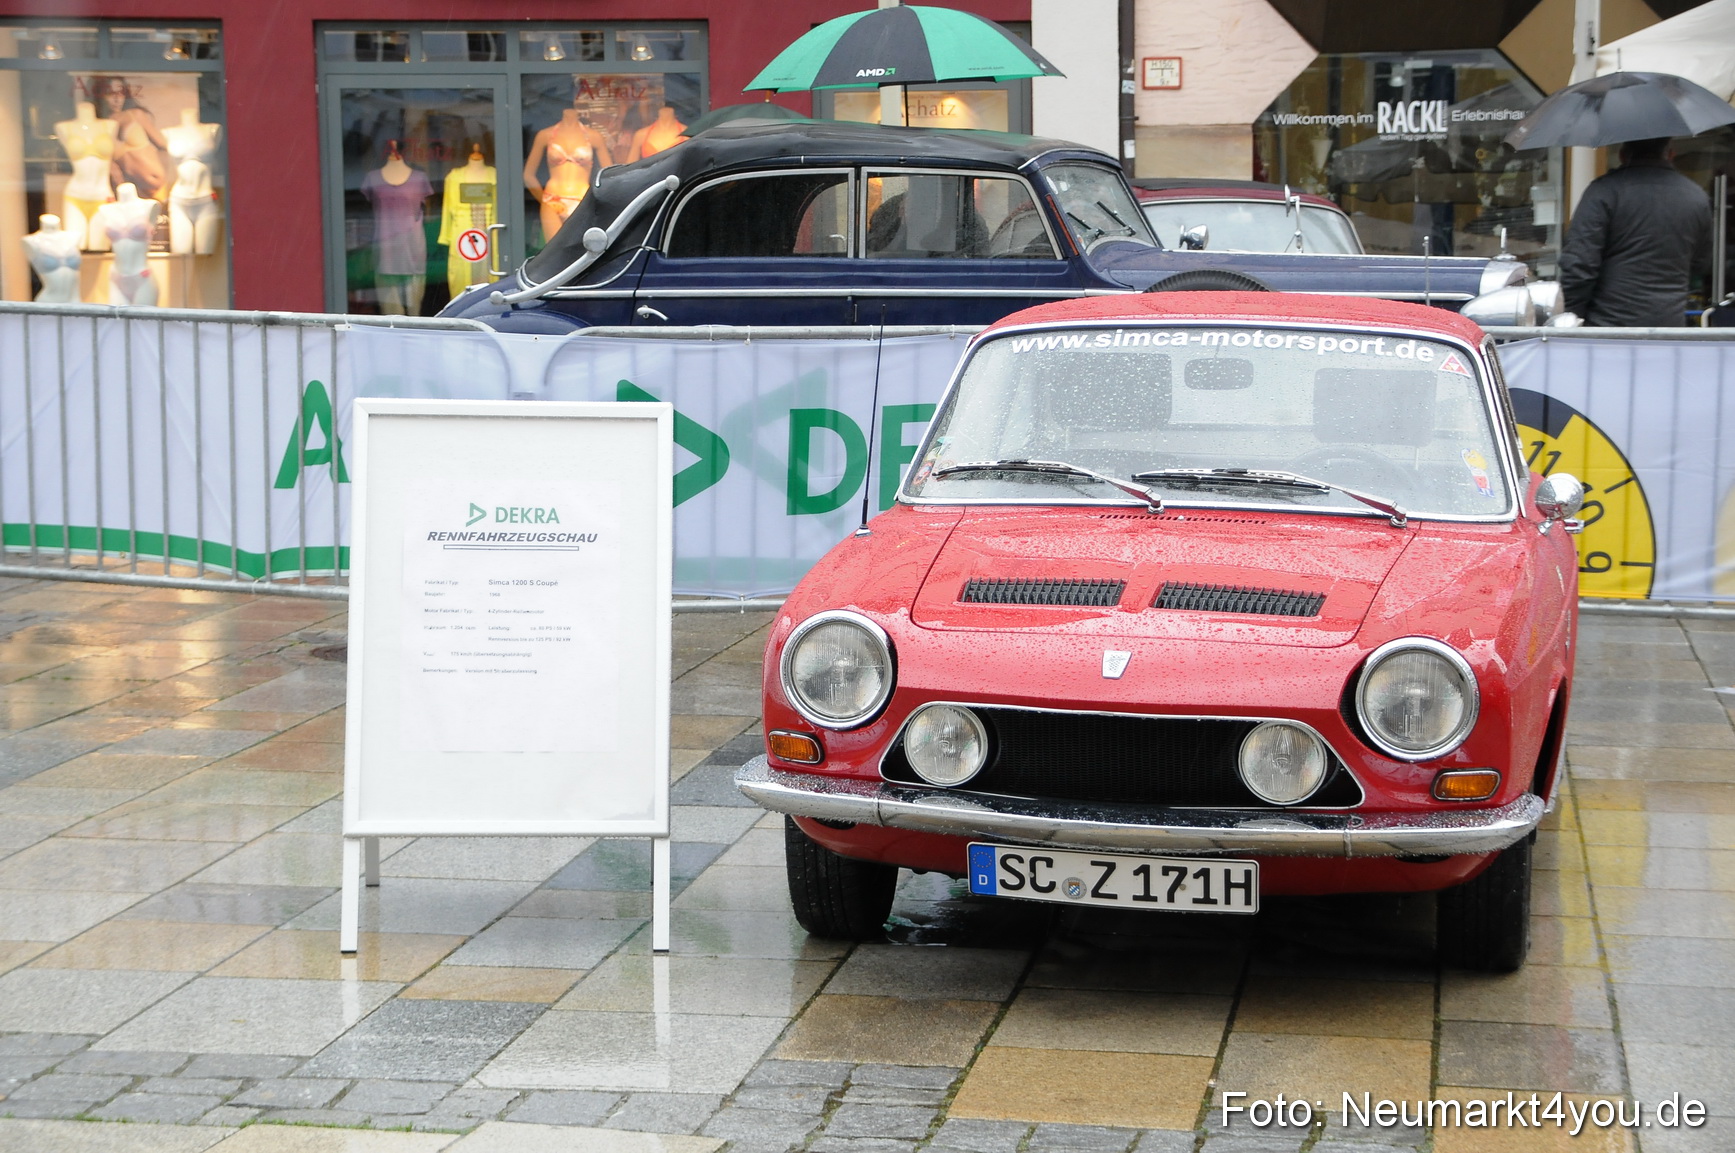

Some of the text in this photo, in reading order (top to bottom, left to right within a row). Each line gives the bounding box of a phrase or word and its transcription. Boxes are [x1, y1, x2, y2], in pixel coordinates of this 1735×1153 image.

[856, 68, 886, 78] AMD
[901, 99, 957, 118] chatz
[1273, 113, 1355, 125] Willkommen
[1357, 112, 1374, 123] im
[1377, 99, 1448, 133] RACKL
[1012, 329, 1435, 363] www.simca-motorsport.de
[495, 507, 560, 524] DEKRA
[427, 531, 598, 544] RENNFAHRZEUGSCHAU
[489, 579, 559, 588] Simca 1200 S Coupé
[979, 873, 989, 885] D
[999, 853, 1057, 893] SC
[1089, 860, 1118, 900] Z
[1131, 863, 1251, 906] 171H
